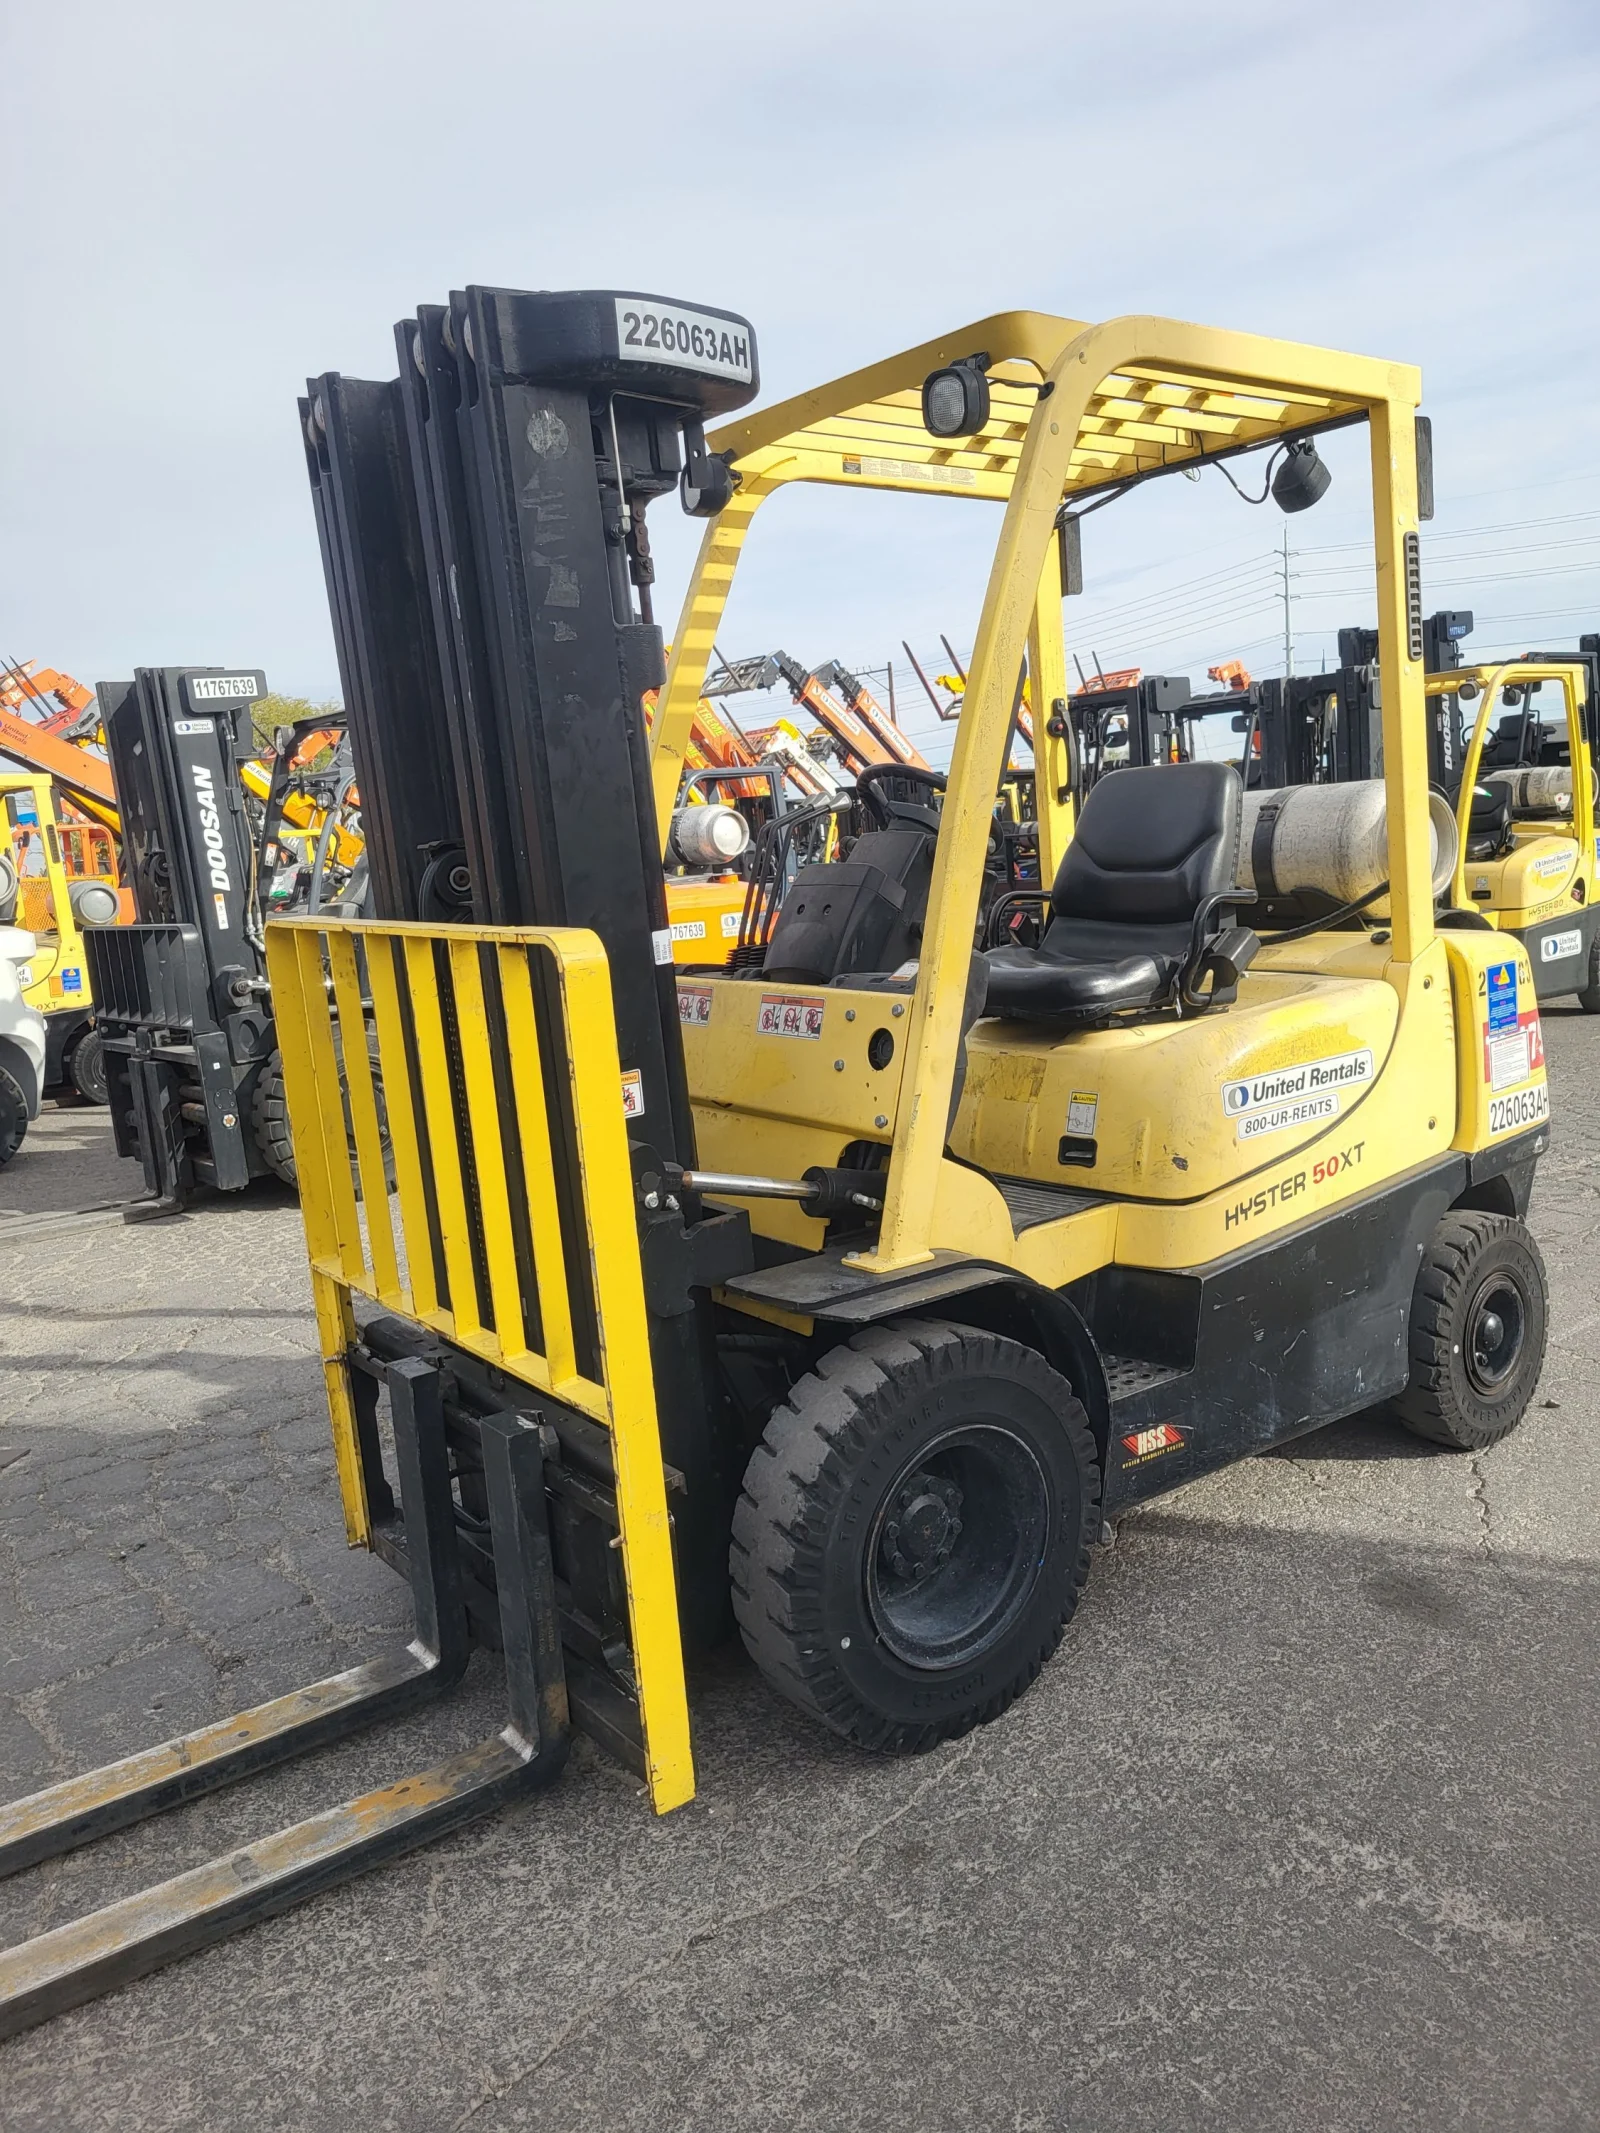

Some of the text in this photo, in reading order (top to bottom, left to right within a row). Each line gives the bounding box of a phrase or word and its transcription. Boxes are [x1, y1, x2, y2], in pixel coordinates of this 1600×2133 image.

[622, 311, 749, 370] 226063AH
[195, 678, 256, 697] 11767639
[1, 728, 28, 746] Rentals
[4, 723, 29, 739] United
[192, 765, 231, 892] DOOSAN
[1528, 901, 1554, 918] HYSTER
[1559, 933, 1578, 946] United
[1559, 943, 1579, 955] Rentals
[1253, 1057, 1366, 1102] United Rentals
[1244, 1098, 1333, 1134] 800-UR-RENTS
[1490, 1085, 1548, 1133] 226063AH
[1225, 1140, 1366, 1231] HYSTER 50XT
[1137, 1425, 1166, 1456] HSS
